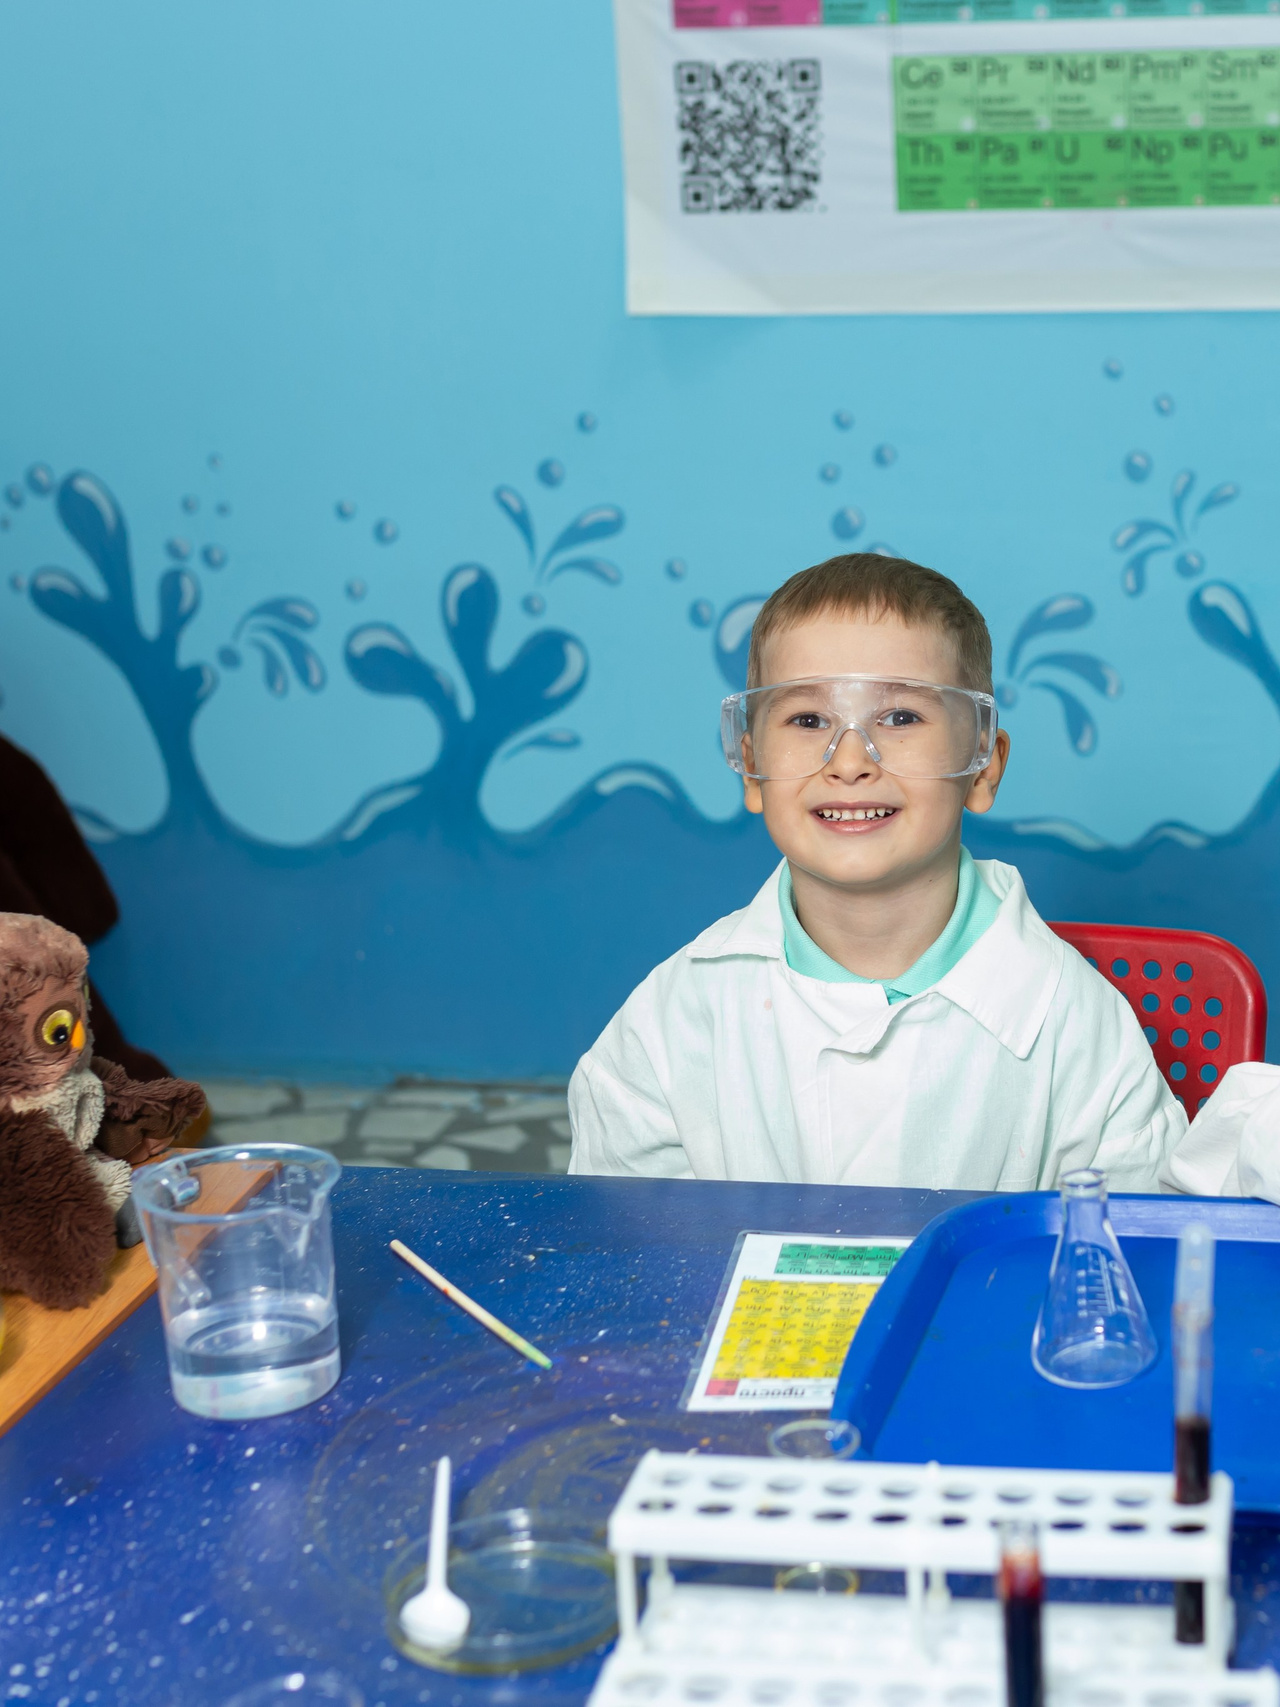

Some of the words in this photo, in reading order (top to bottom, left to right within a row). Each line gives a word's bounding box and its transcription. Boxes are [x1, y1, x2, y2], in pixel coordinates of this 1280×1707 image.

[901, 59, 944, 88] Ce
[978, 58, 1010, 84] Pr
[1054, 57, 1096, 83] Nd
[1131, 54, 1182, 81] Pm
[1208, 52, 1258, 81] Sm
[906, 138, 944, 164] Th
[981, 137, 1019, 164] Pa
[1056, 137, 1080, 163] U
[1132, 136, 1174, 163] Np
[1209, 133, 1248, 160] Pu
